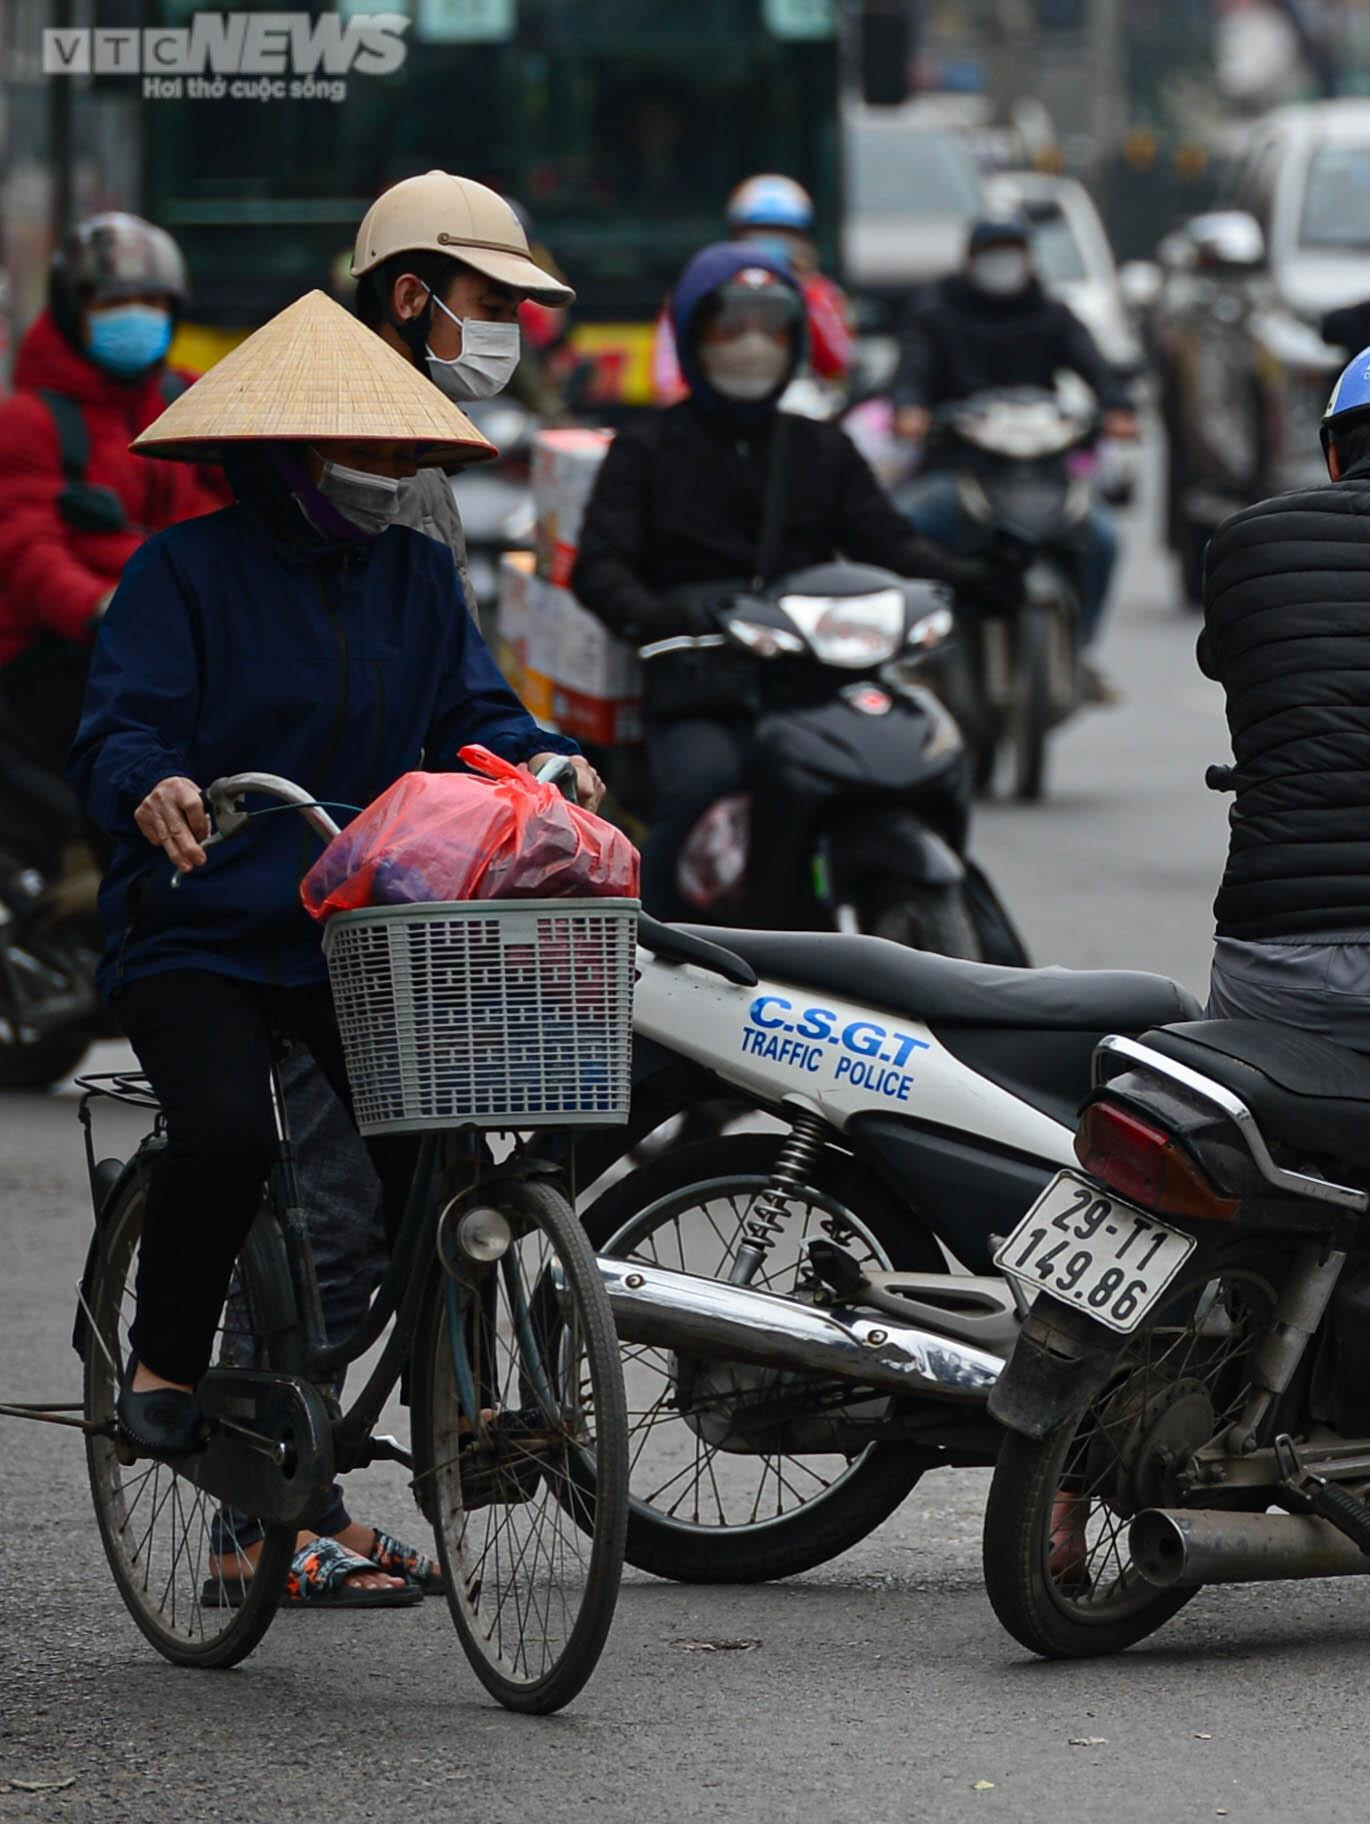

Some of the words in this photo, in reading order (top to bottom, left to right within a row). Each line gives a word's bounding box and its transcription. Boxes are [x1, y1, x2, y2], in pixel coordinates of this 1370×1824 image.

[741, 1027, 824, 1072] TRAFFIC
[834, 1056, 914, 1101] POLICE
[750, 996, 930, 1068] C.S.G.T
[1051, 1189, 1168, 1271] 29-T1
[1014, 1228, 1148, 1321] 149.86
